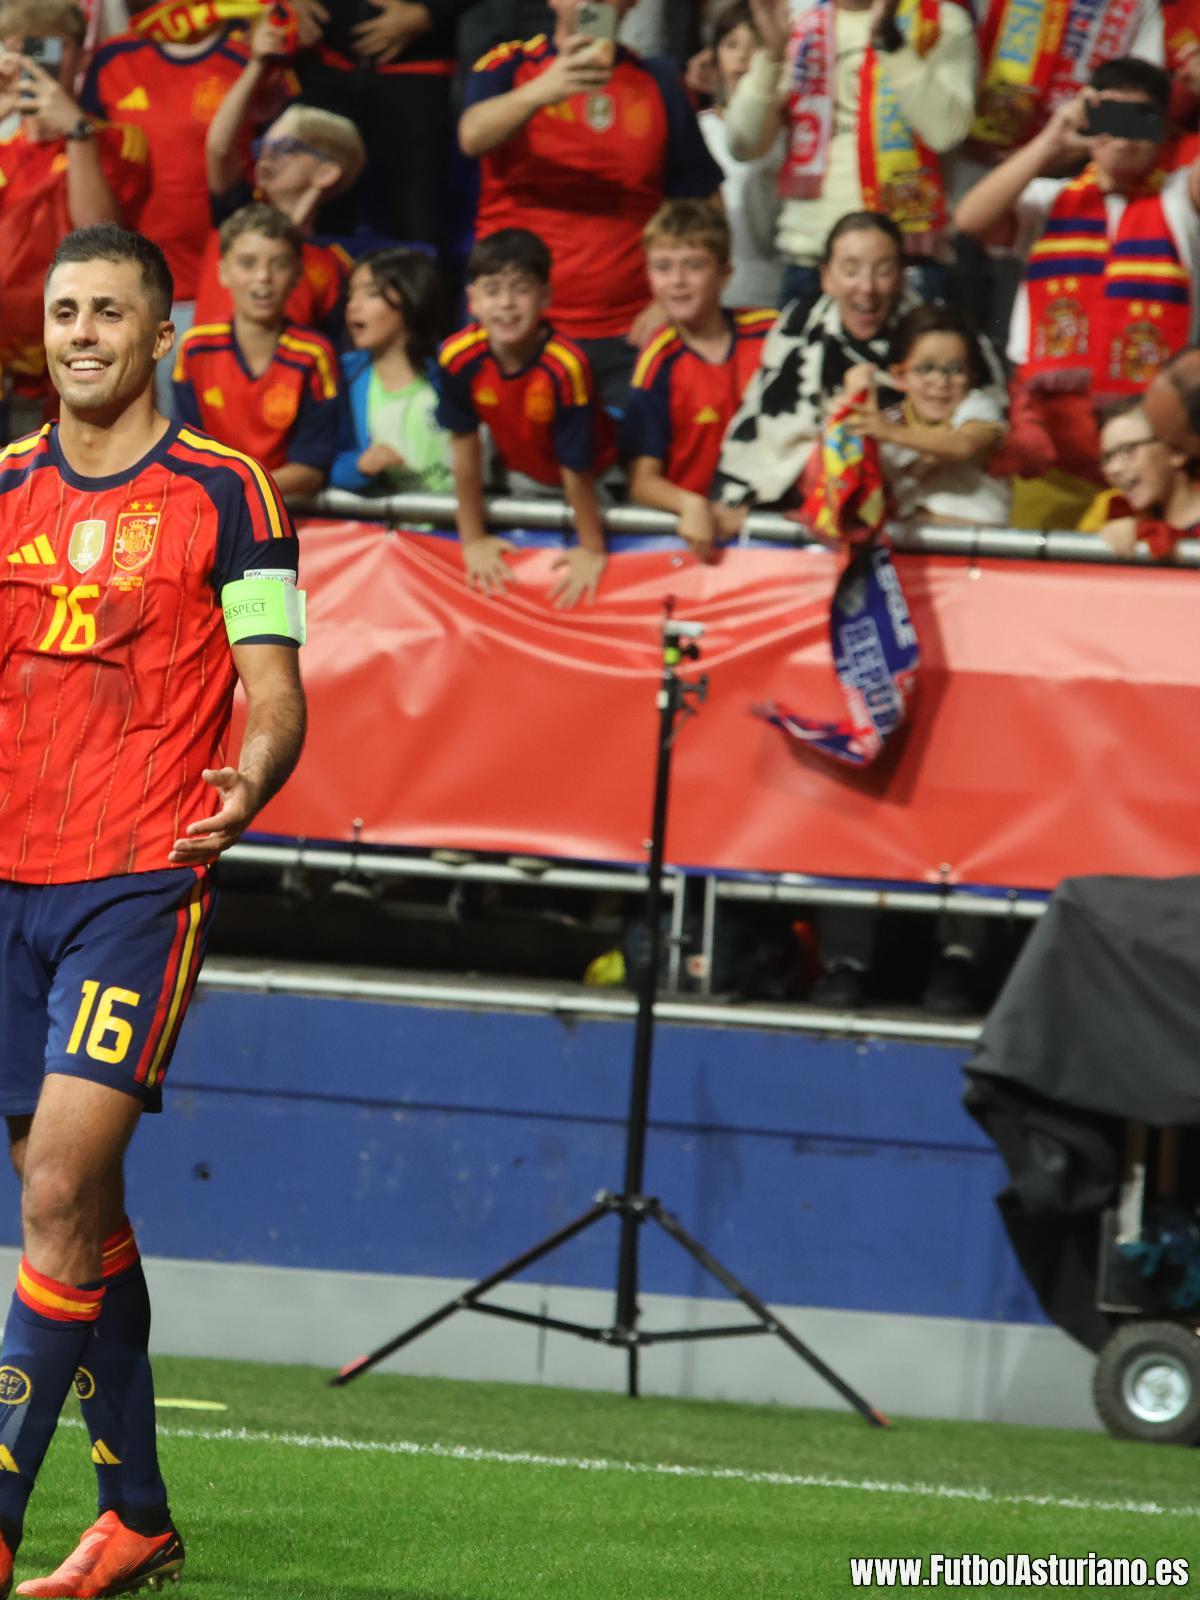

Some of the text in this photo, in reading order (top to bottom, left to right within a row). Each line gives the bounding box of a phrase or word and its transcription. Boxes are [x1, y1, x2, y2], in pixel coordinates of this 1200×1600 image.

[38, 584, 99, 652] 16
[224, 601, 266, 620] RESPECT
[65, 979, 141, 1064] 16
